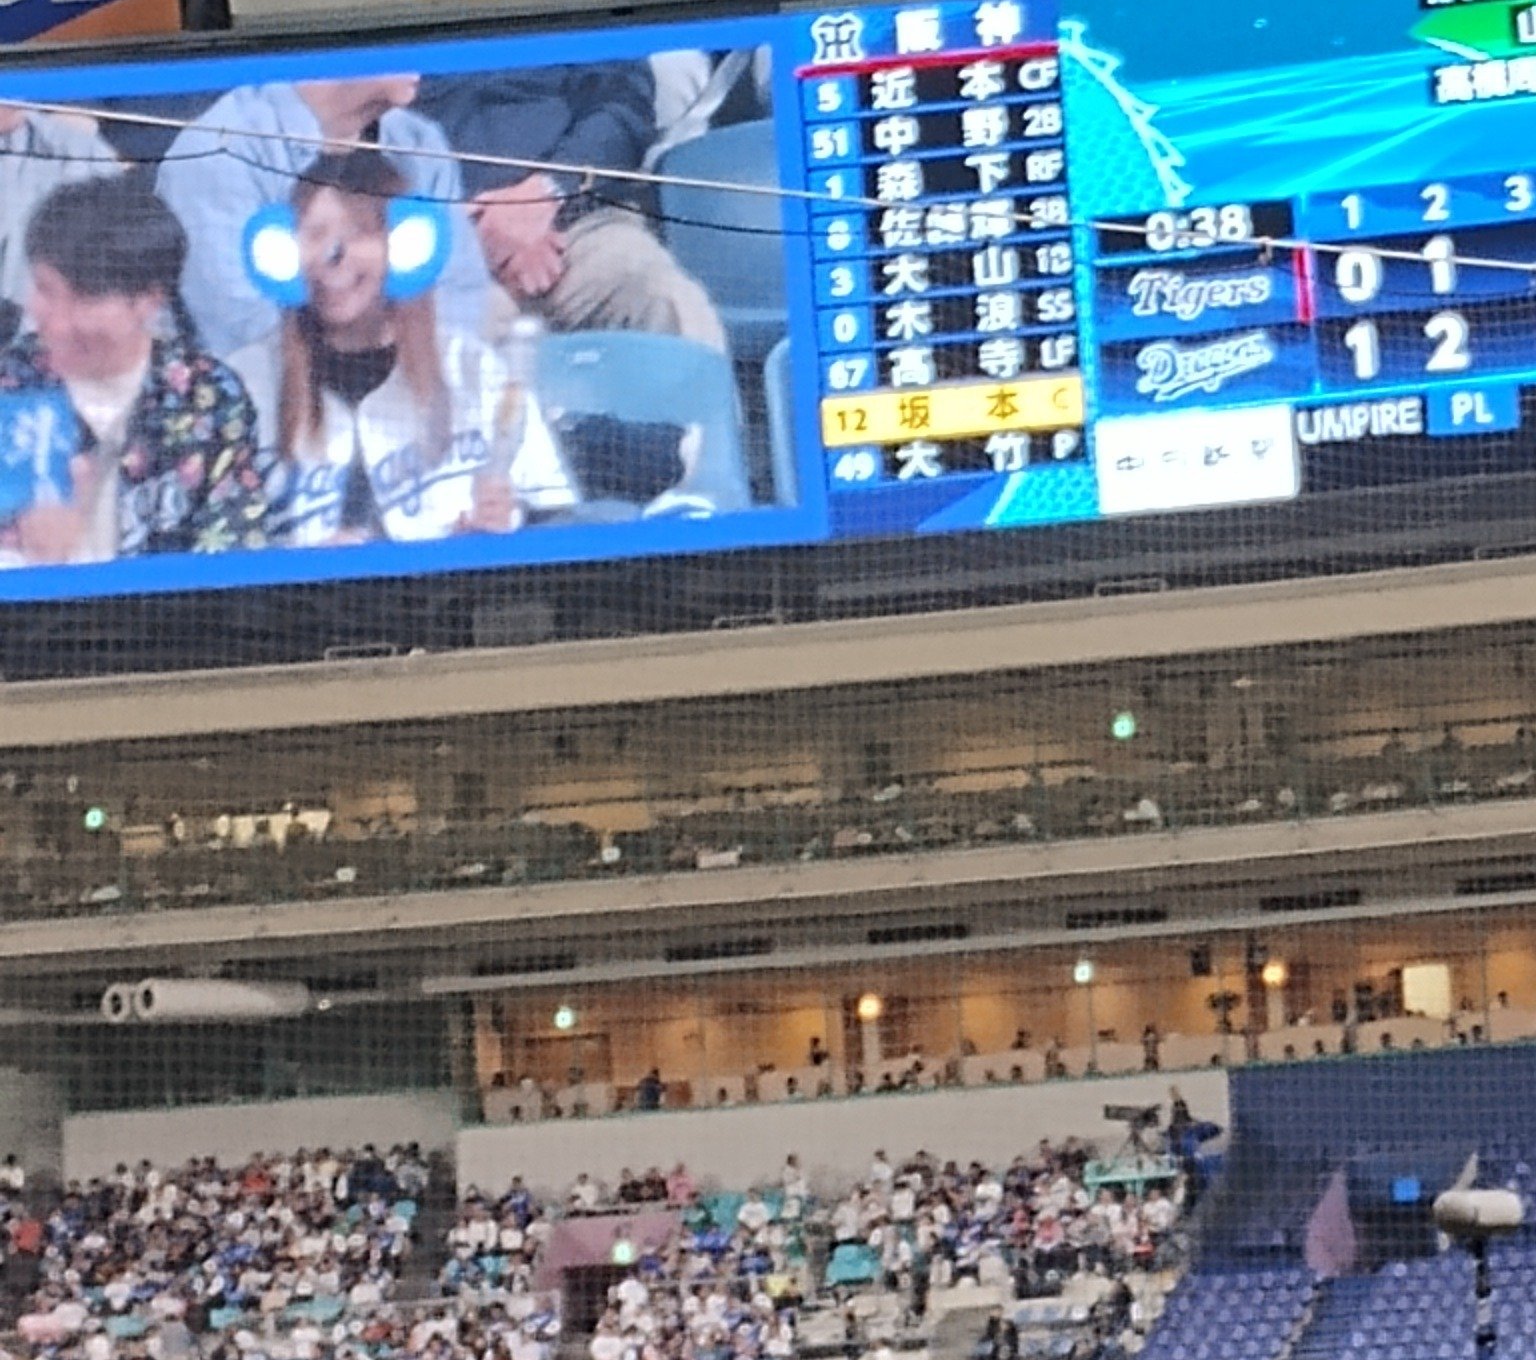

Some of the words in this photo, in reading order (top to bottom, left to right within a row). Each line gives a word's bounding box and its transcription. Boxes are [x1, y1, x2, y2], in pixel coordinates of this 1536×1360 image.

[817, 82, 842, 112] 5
[872, 59, 1005, 110] 近本
[1018, 57, 1059, 90] CF
[813, 127, 849, 159] 51
[873, 106, 1010, 156] 中野
[1023, 103, 1063, 137] 2B
[826, 174, 844, 200] 1
[1341, 194, 1362, 229] 1
[1419, 182, 1450, 221] 2
[1503, 174, 1534, 212] 3
[1145, 204, 1252, 252] 0:38
[830, 267, 855, 297] 3
[883, 246, 1019, 296] 大山
[1128, 269, 1272, 321] Tigers
[1336, 248, 1381, 303] 0
[1421, 235, 1456, 294] 1
[833, 313, 858, 343] 0
[1037, 288, 1075, 322] SS
[829, 358, 868, 390] 67
[1039, 334, 1075, 369] LF
[1344, 320, 1380, 379] 1
[1424, 311, 1472, 371] 2
[837, 409, 868, 432] 12
[899, 390, 1019, 429] 坂本
[1297, 396, 1423, 443] UMPIRE
[1451, 392, 1494, 425] PL
[895, 432, 1031, 480] 大竹
[1052, 430, 1079, 460] P
